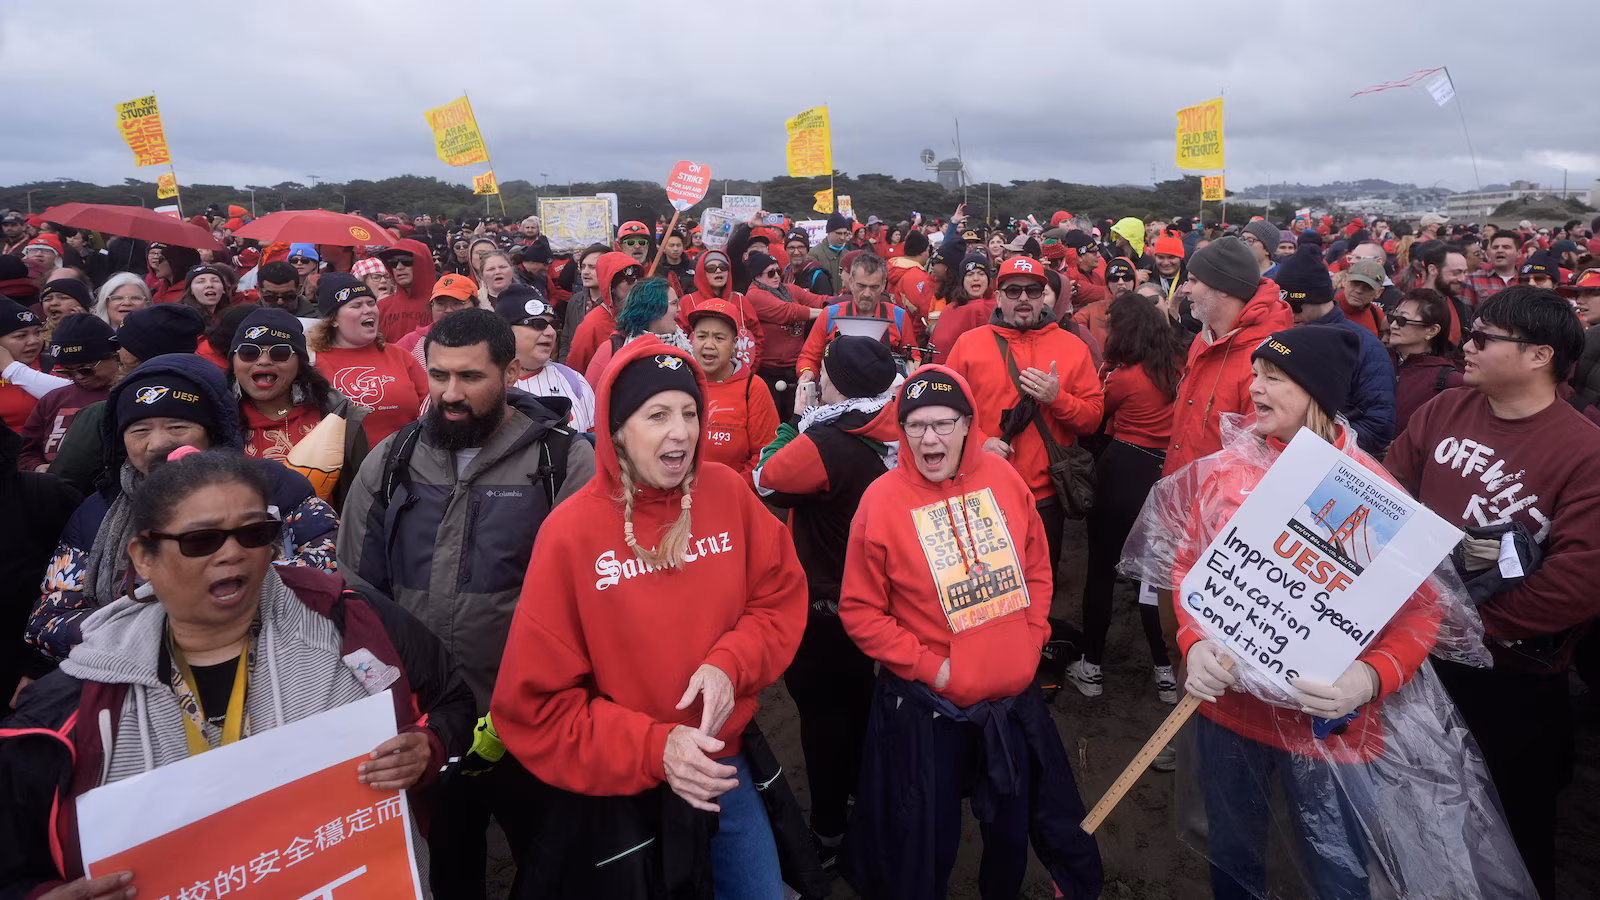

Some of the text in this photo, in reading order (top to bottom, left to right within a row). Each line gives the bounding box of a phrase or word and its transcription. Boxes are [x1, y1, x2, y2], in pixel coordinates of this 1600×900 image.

[688, 165, 701, 173] ON
[677, 172, 703, 185] STRIKE
[271, 329, 291, 339] UESF
[63, 345, 82, 353] UESF
[1269, 340, 1292, 355] UESF
[931, 382, 953, 392] UESF
[172, 390, 199, 403] UESF
[708, 431, 731, 442] 1493
[493, 490, 523, 498] Columbia
[1338, 466, 1408, 516] UNITED EDUCATORS
[1343, 480, 1362, 495] SAN
[1360, 491, 1400, 521] FRANCISCO
[1273, 530, 1354, 593] UESF
[1223, 526, 1375, 647] Improve Special
[1206, 549, 1311, 641] Education
[1204, 575, 1289, 655] Working
[953, 614, 969, 632] WE
